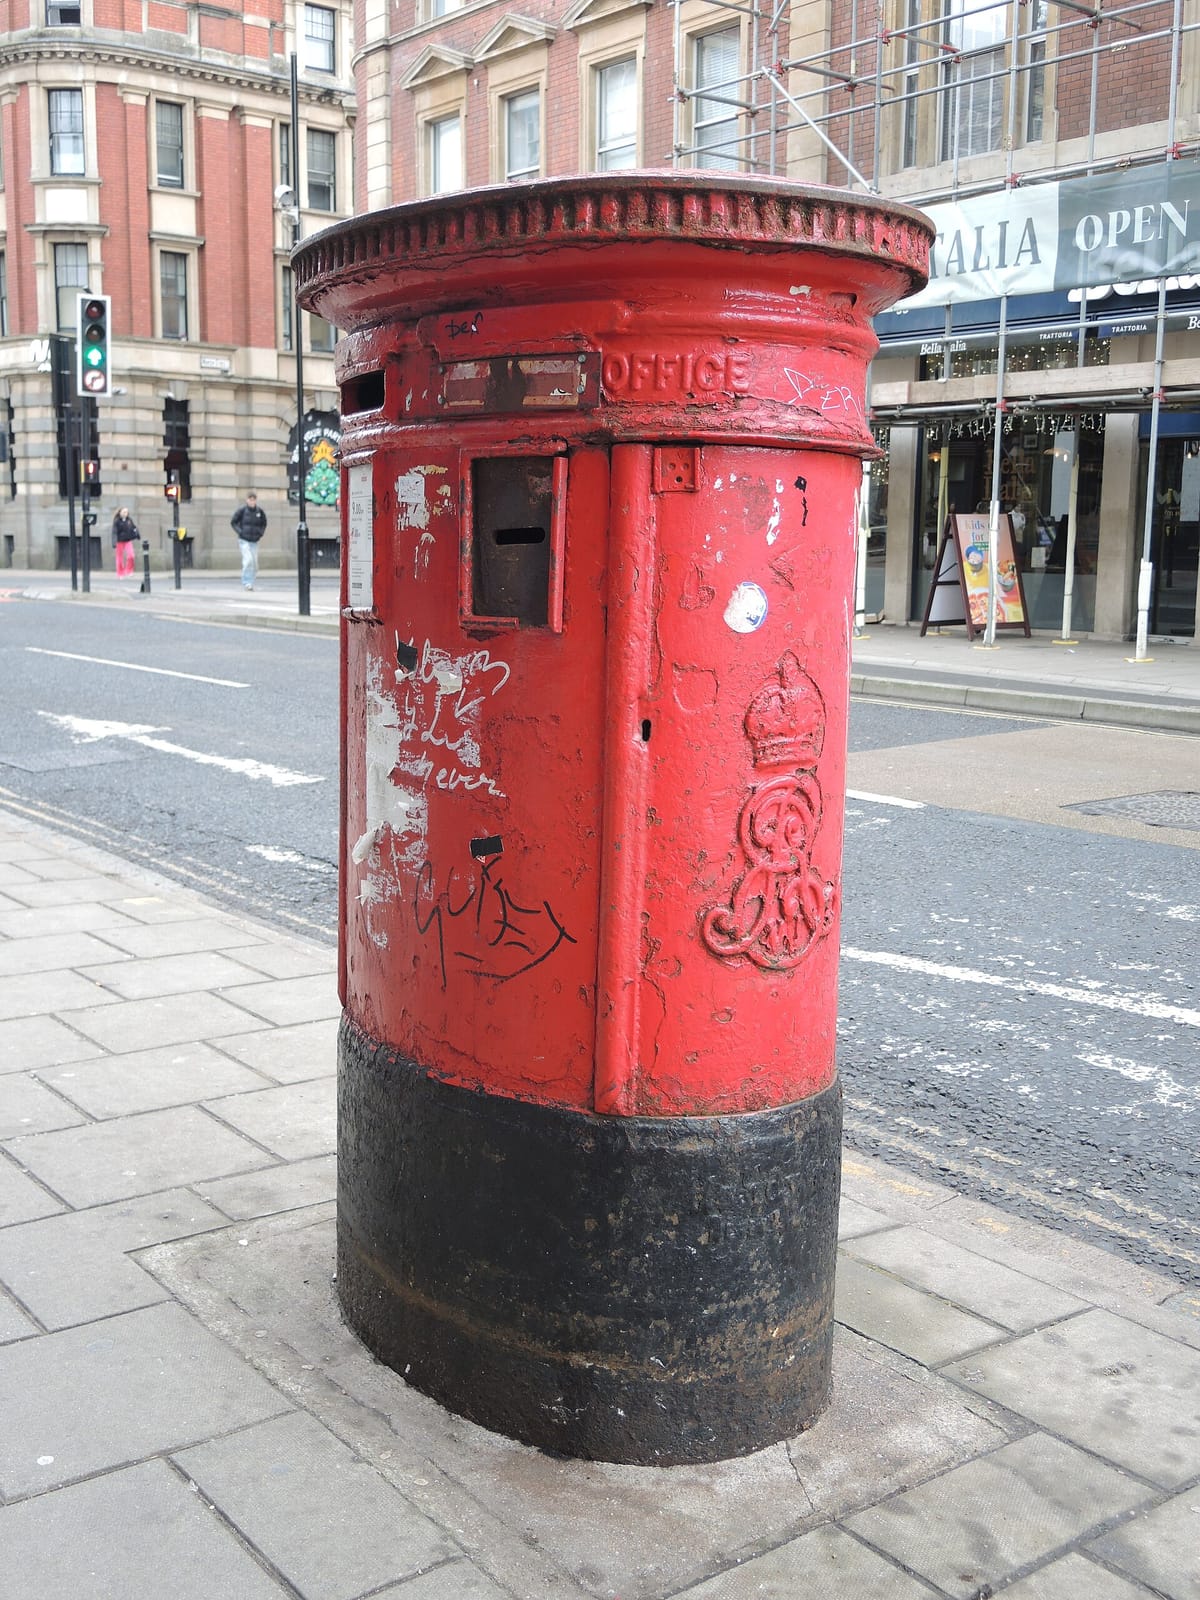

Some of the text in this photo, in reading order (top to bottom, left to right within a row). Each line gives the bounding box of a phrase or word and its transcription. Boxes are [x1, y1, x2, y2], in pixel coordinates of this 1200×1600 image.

[1075, 200, 1190, 252] OPEN
[1111, 324, 1147, 333] TRATTORIA
[1039, 331, 1073, 340] TRATTORIA
[920, 342, 942, 355] Bella
[602, 352, 750, 393] OFFICE
